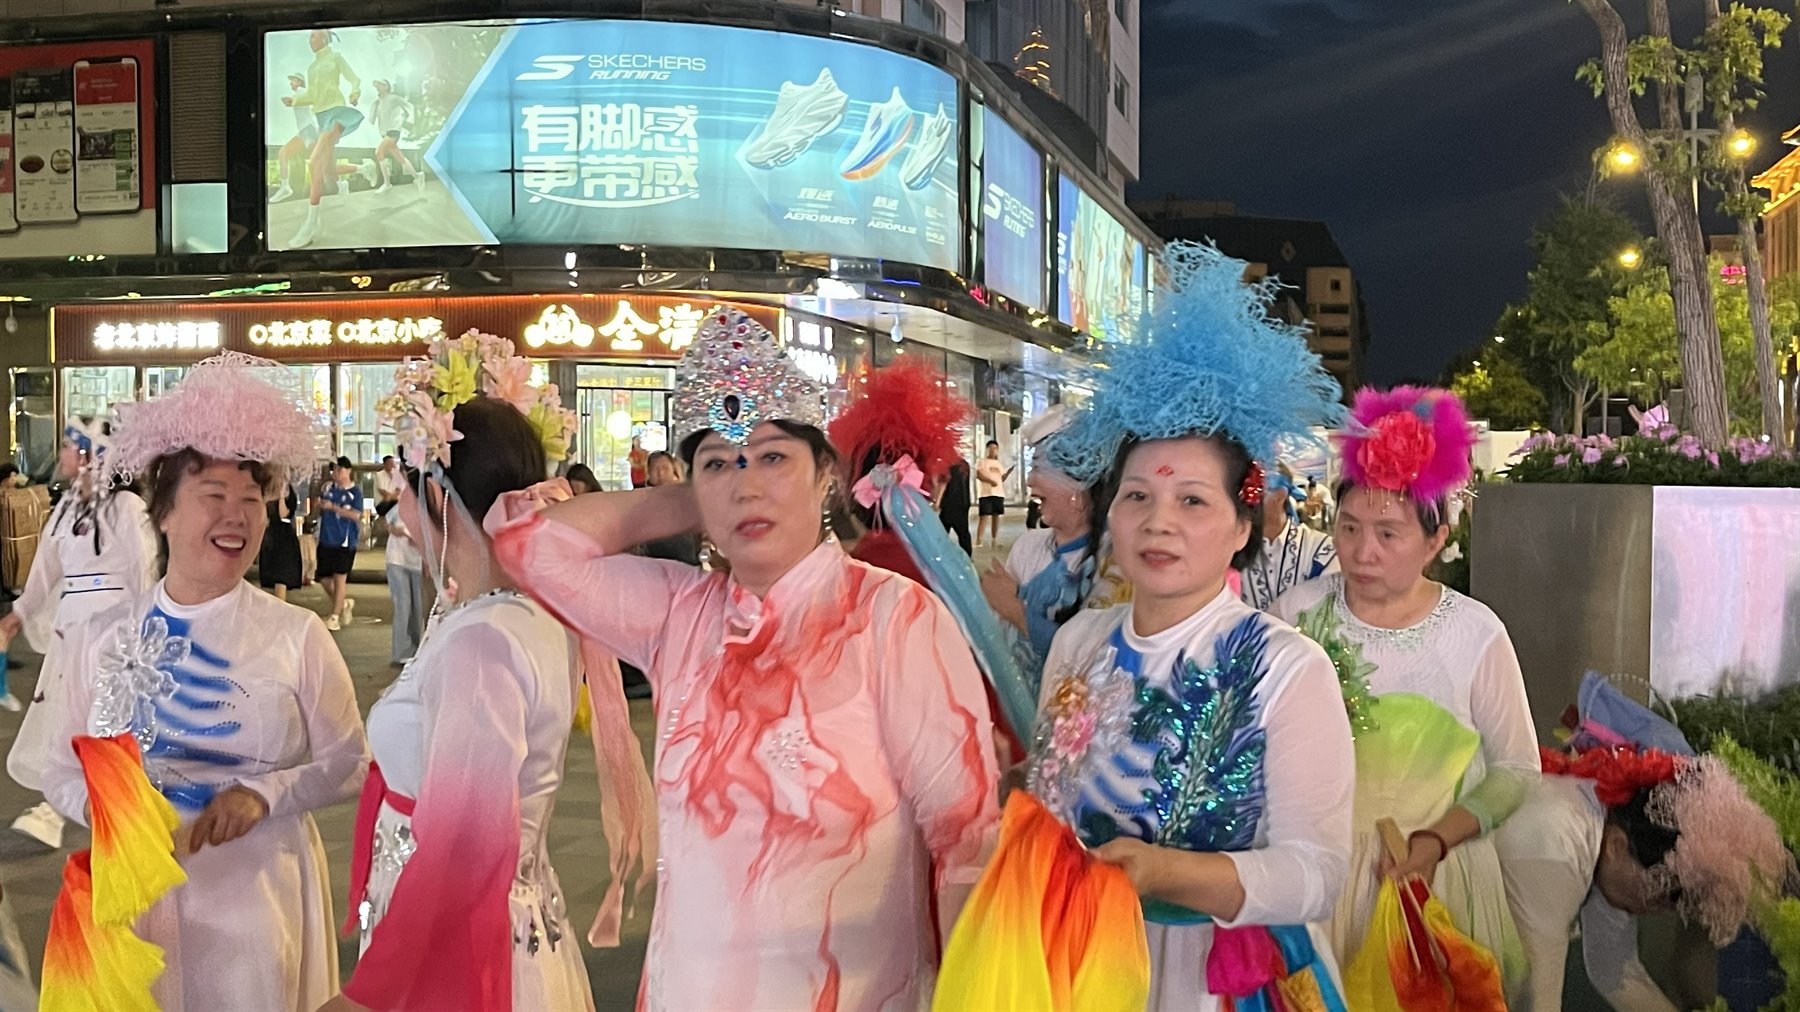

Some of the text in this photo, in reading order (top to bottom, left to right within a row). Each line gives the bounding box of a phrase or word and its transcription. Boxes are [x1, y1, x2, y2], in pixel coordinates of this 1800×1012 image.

[587, 54, 706, 71] SKECHERS
[589, 70, 671, 80] RUNNING
[521, 103, 700, 153] 有脚感
[521, 154, 700, 203] 更带感
[783, 211, 819, 222] AERO
[819, 214, 858, 226] BURST
